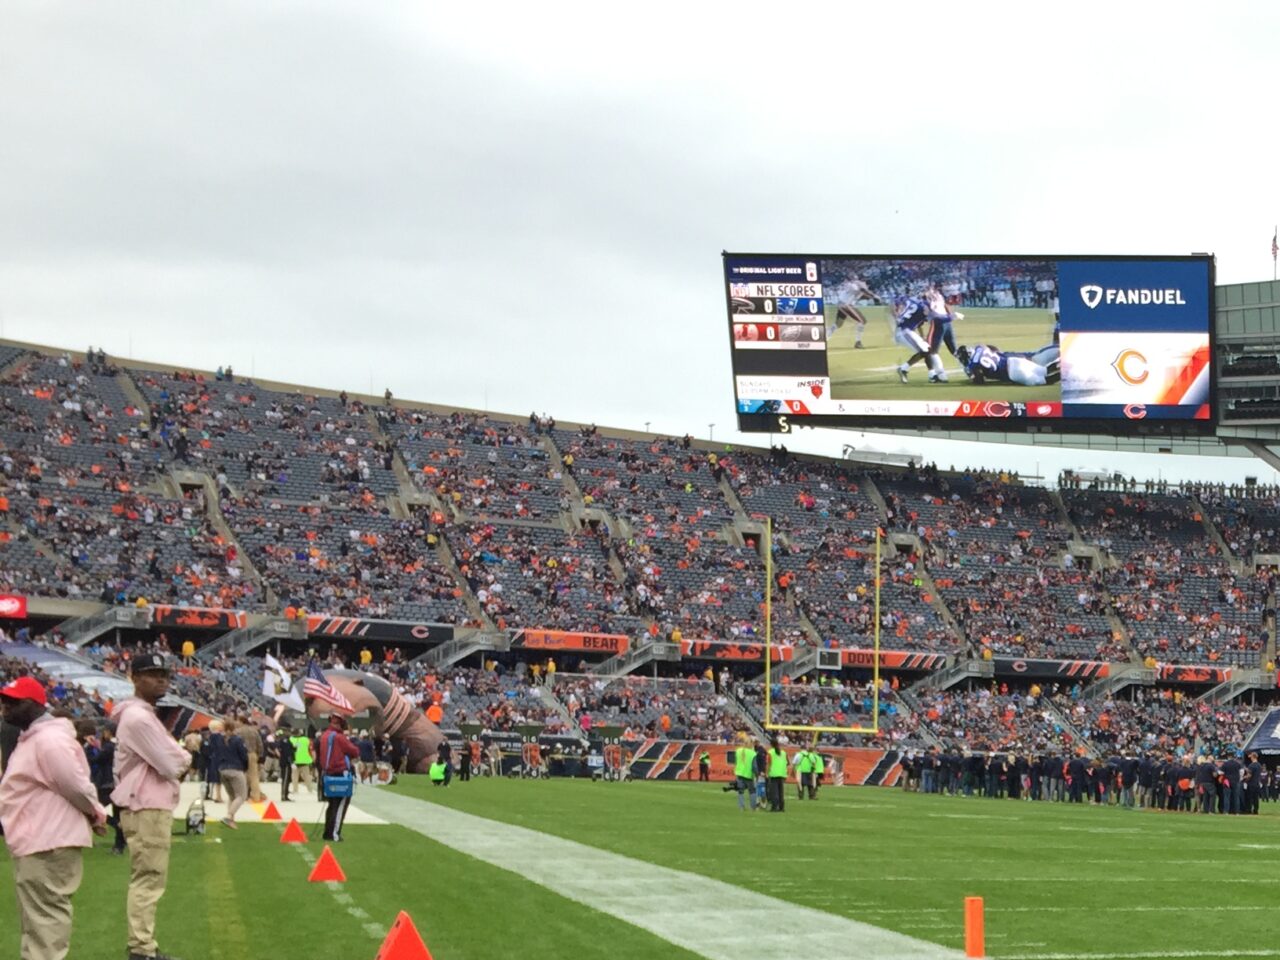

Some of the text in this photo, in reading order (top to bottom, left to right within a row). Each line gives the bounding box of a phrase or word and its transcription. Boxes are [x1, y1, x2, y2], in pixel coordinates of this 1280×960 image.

[756, 285, 776, 296] NFL
[778, 285, 816, 297] SCORES
[1106, 289, 1186, 304] FANDUEL
[764, 299, 818, 314] 0 0
[797, 379, 826, 388] INSIDE
[583, 636, 619, 650] BEAR
